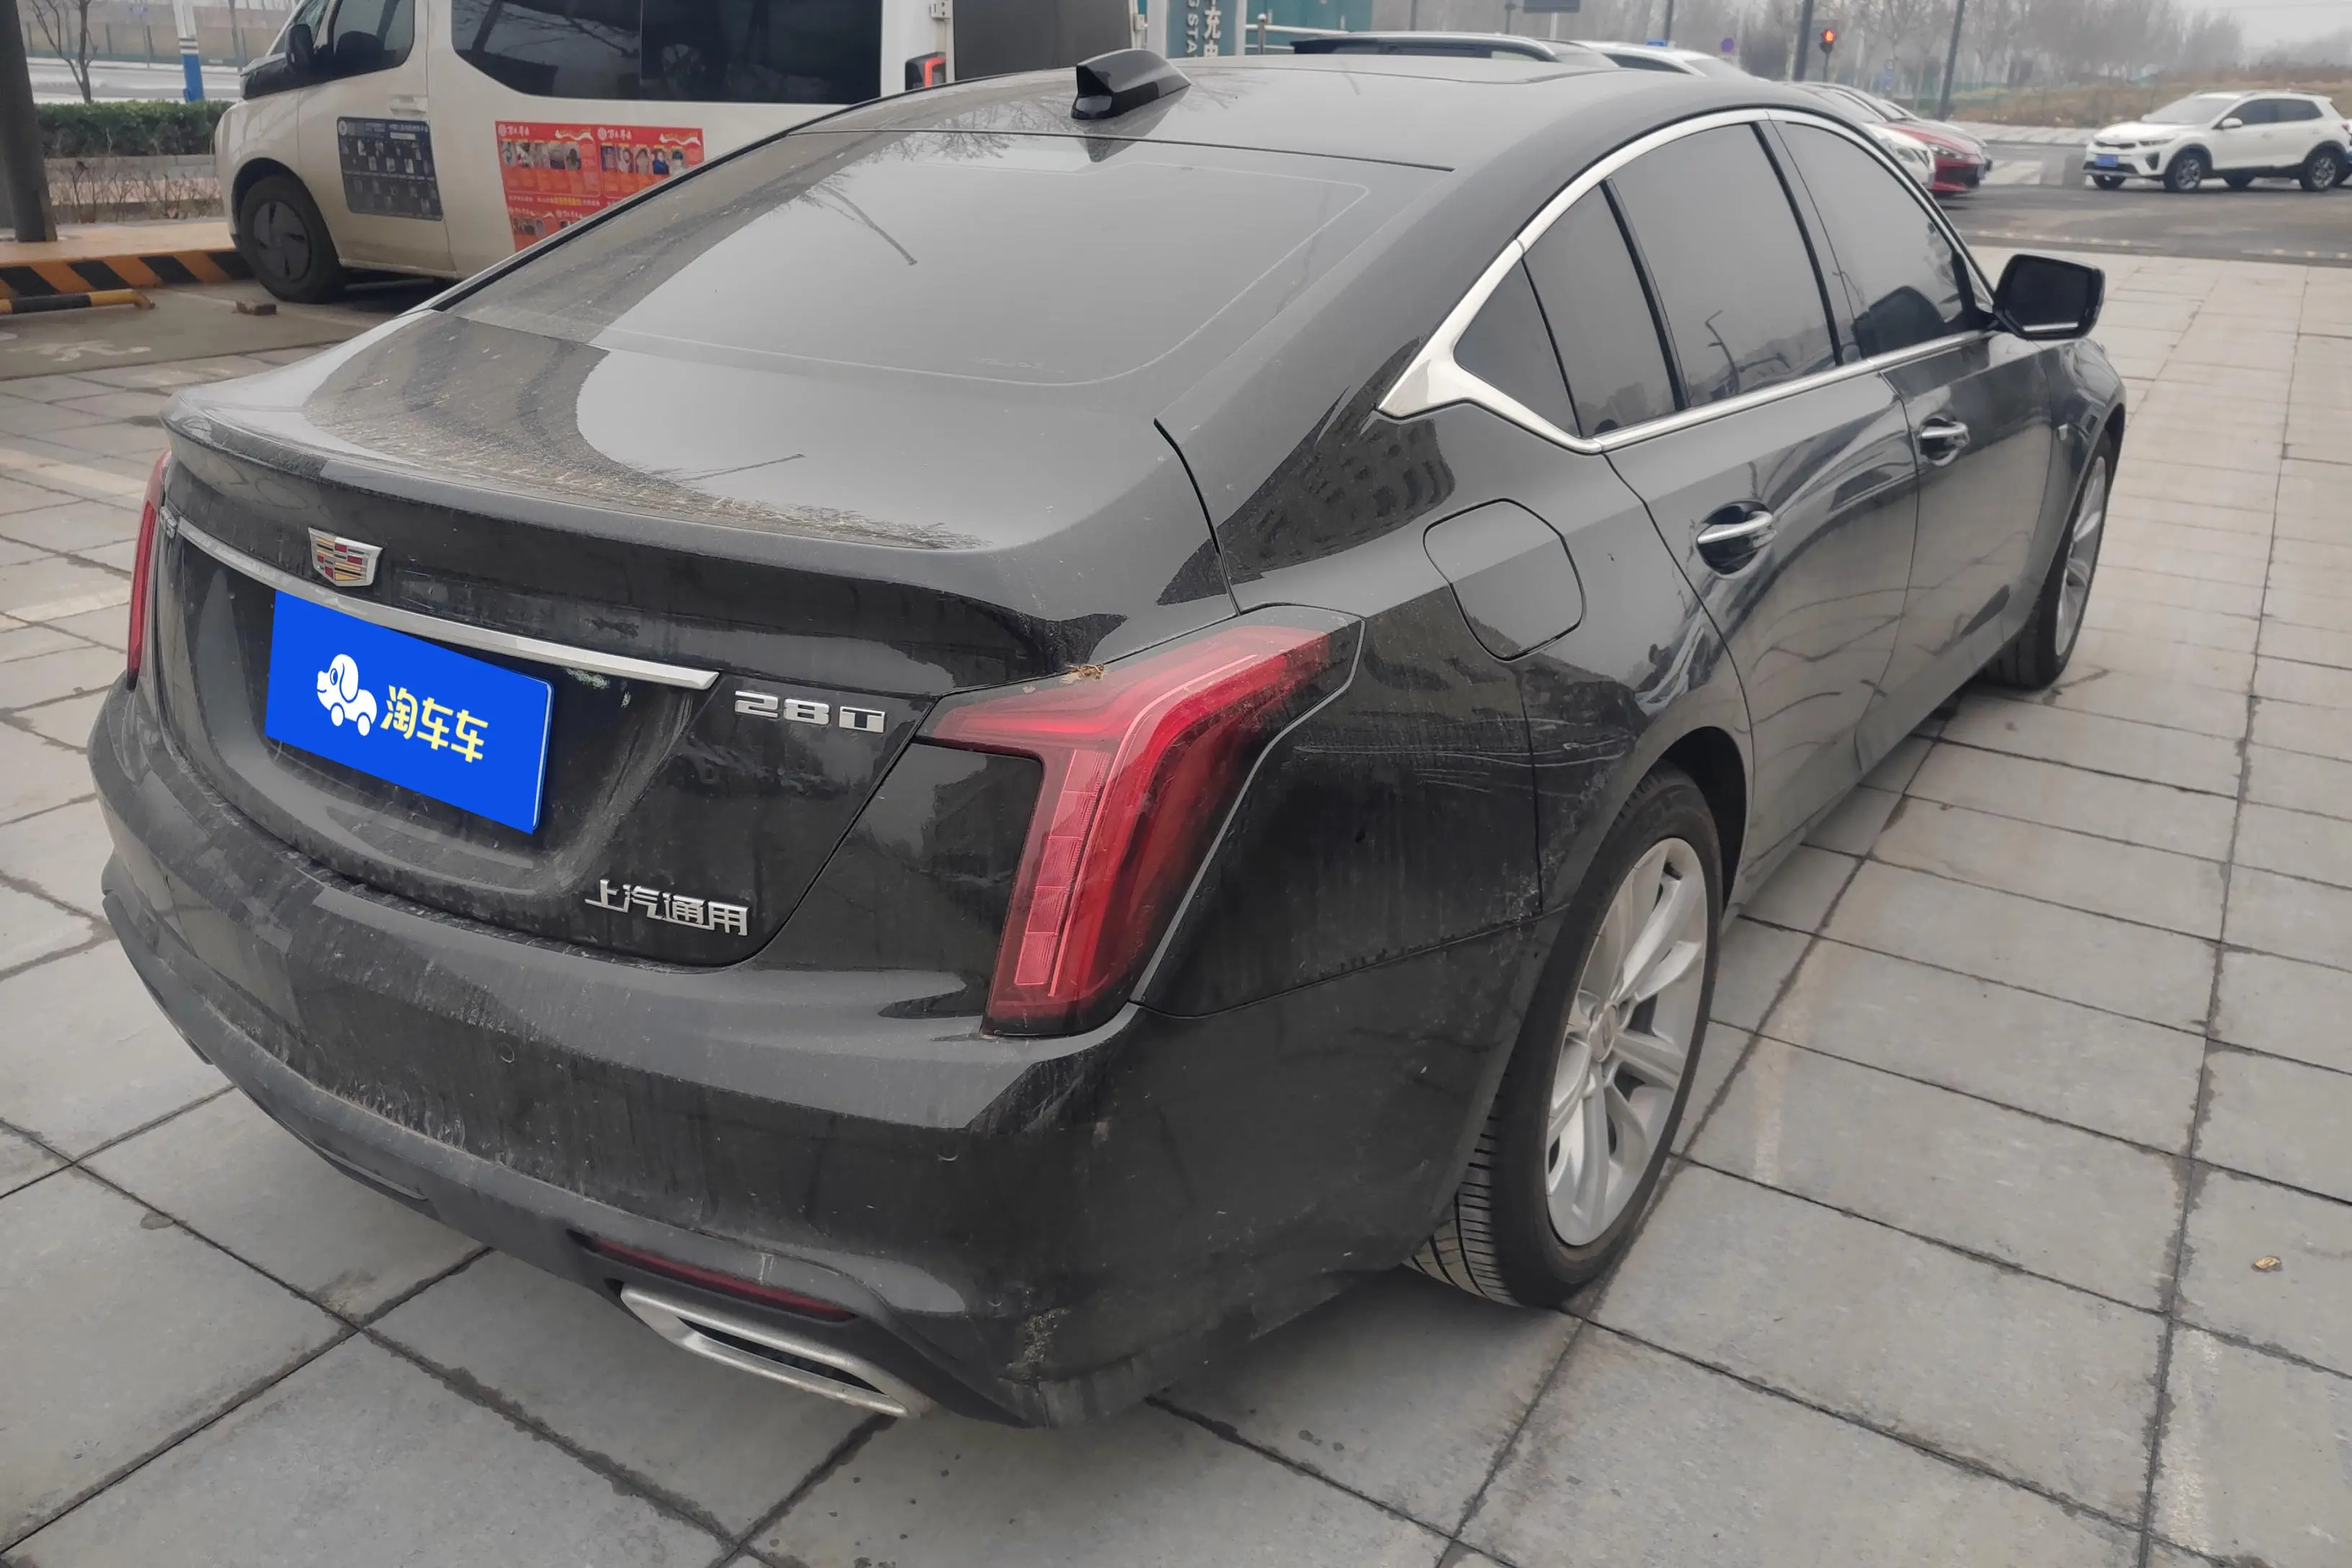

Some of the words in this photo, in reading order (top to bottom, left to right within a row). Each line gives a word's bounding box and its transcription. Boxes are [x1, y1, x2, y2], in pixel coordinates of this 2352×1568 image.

[1187, 13, 1199, 57] STA
[1203, 0, 1221, 57] 充电
[734, 690, 886, 733] 28T
[584, 878, 749, 936] 上汽通用
